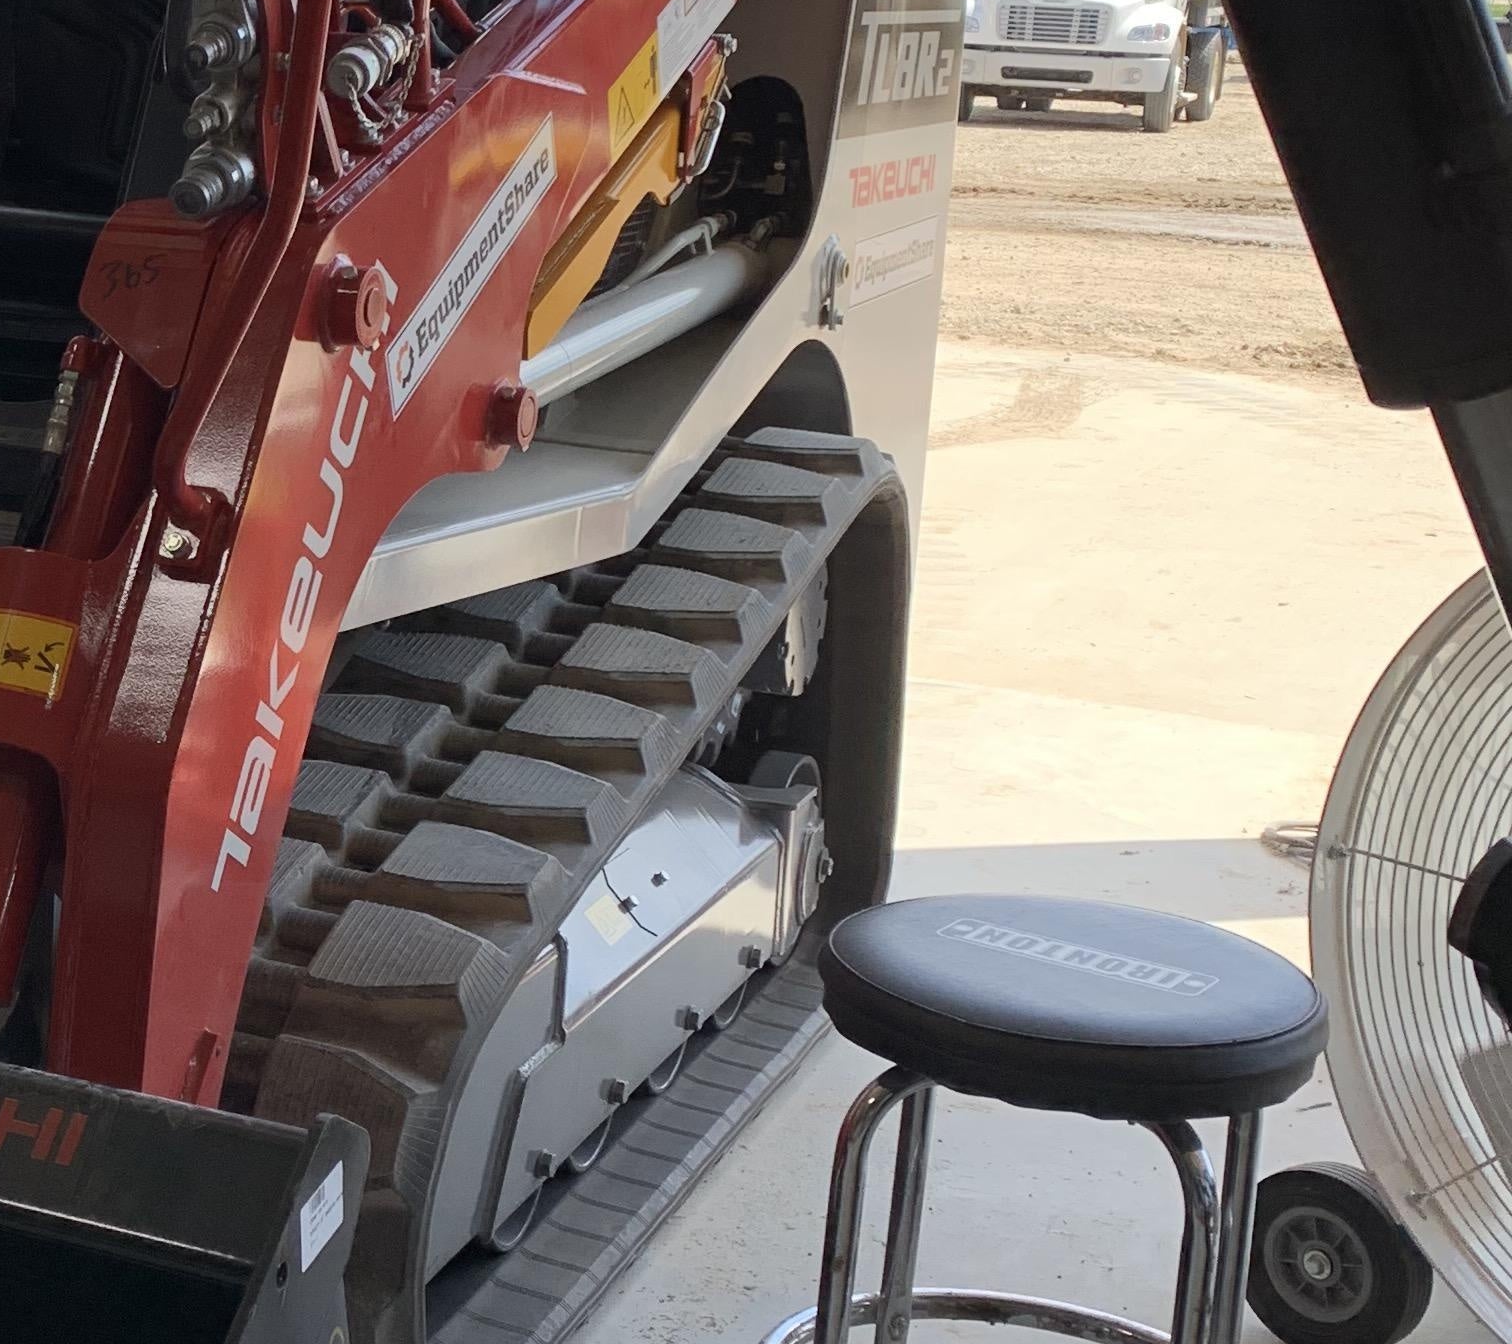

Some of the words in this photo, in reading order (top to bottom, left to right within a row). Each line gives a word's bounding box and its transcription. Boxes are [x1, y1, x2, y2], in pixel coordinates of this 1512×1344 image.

[858, 9, 961, 106] TL8R2
[849, 154, 937, 208] TAKEUCHI
[416, 144, 550, 357] EquipmentShare
[975, 926, 1181, 989] IRONTON
